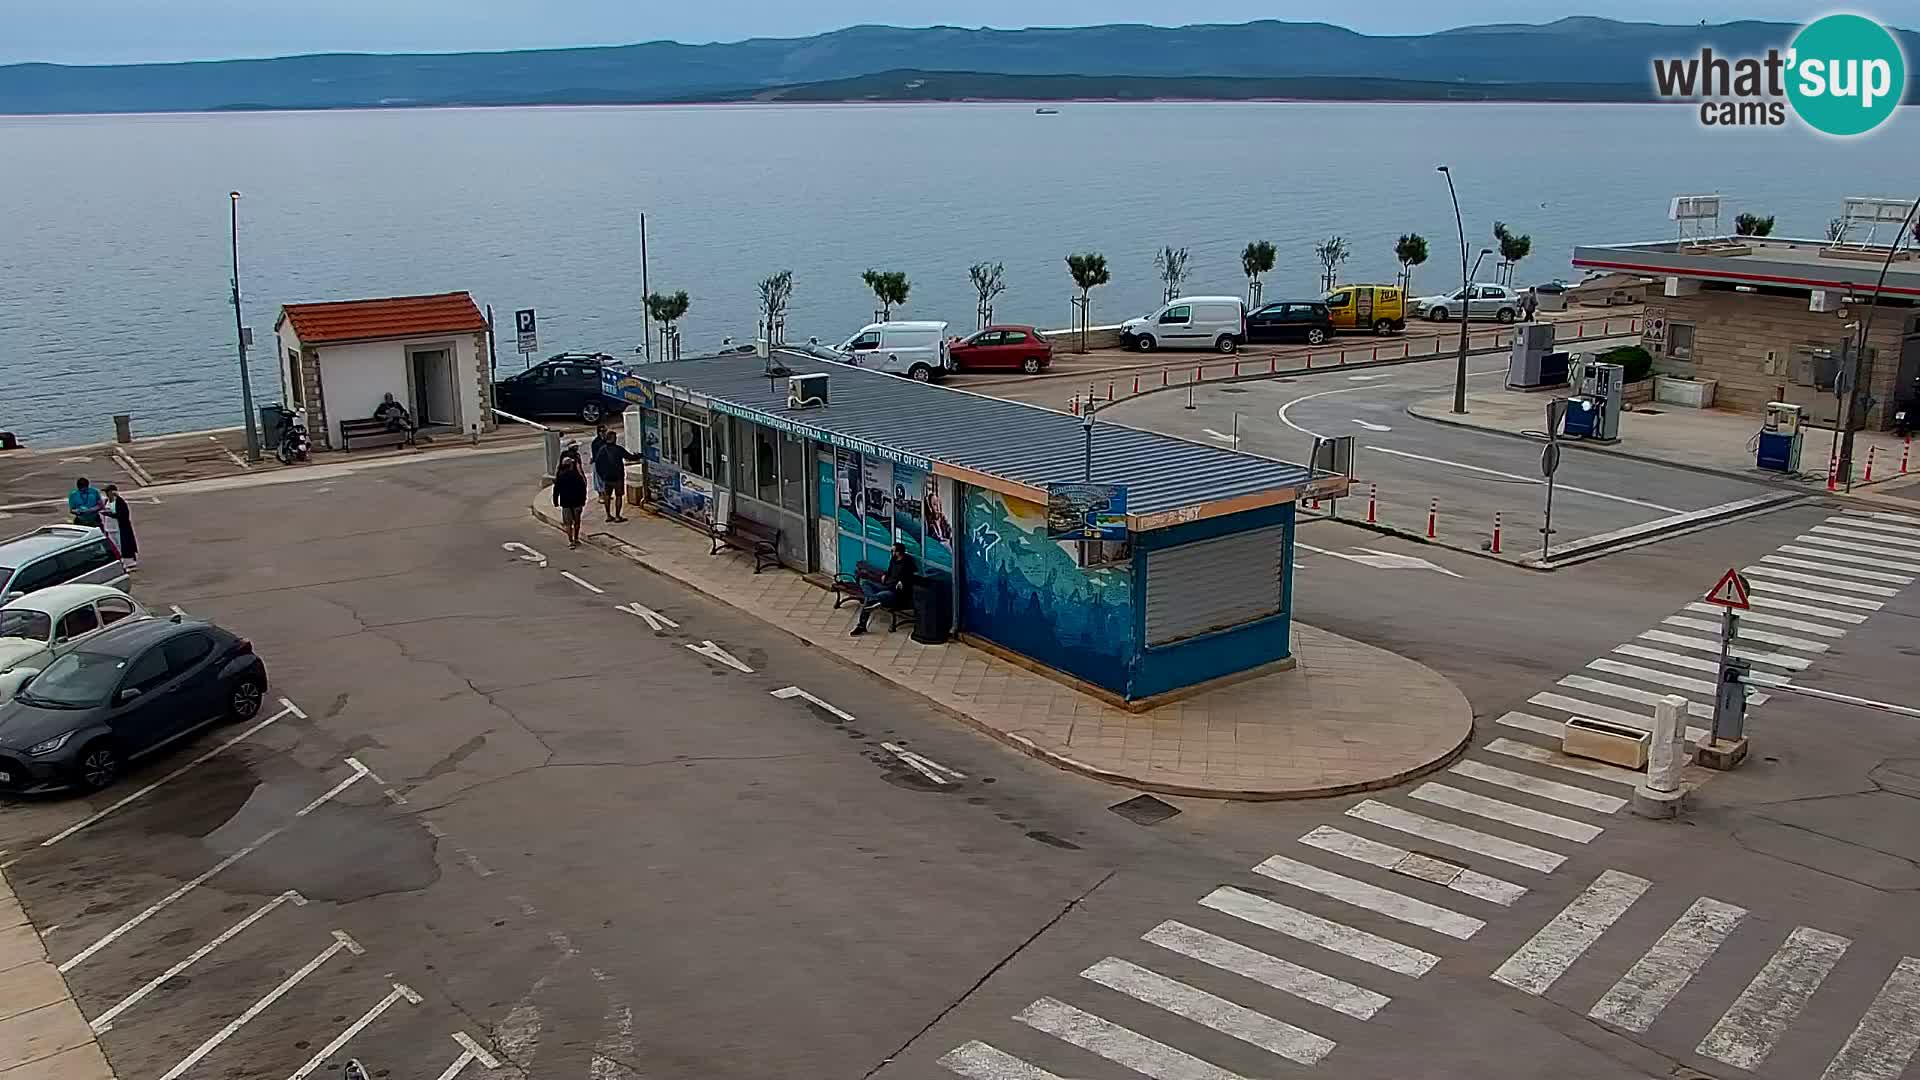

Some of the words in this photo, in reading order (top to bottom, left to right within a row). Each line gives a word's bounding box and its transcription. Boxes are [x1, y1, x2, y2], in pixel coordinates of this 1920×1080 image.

[520, 312, 530, 330] P
[792, 423, 821, 441] POSTAJA
[830, 434, 845, 446] BUS
[845, 437, 876, 456] STATION
[877, 447, 902, 463] TICKET
[903, 455, 929, 470] OFFICE
